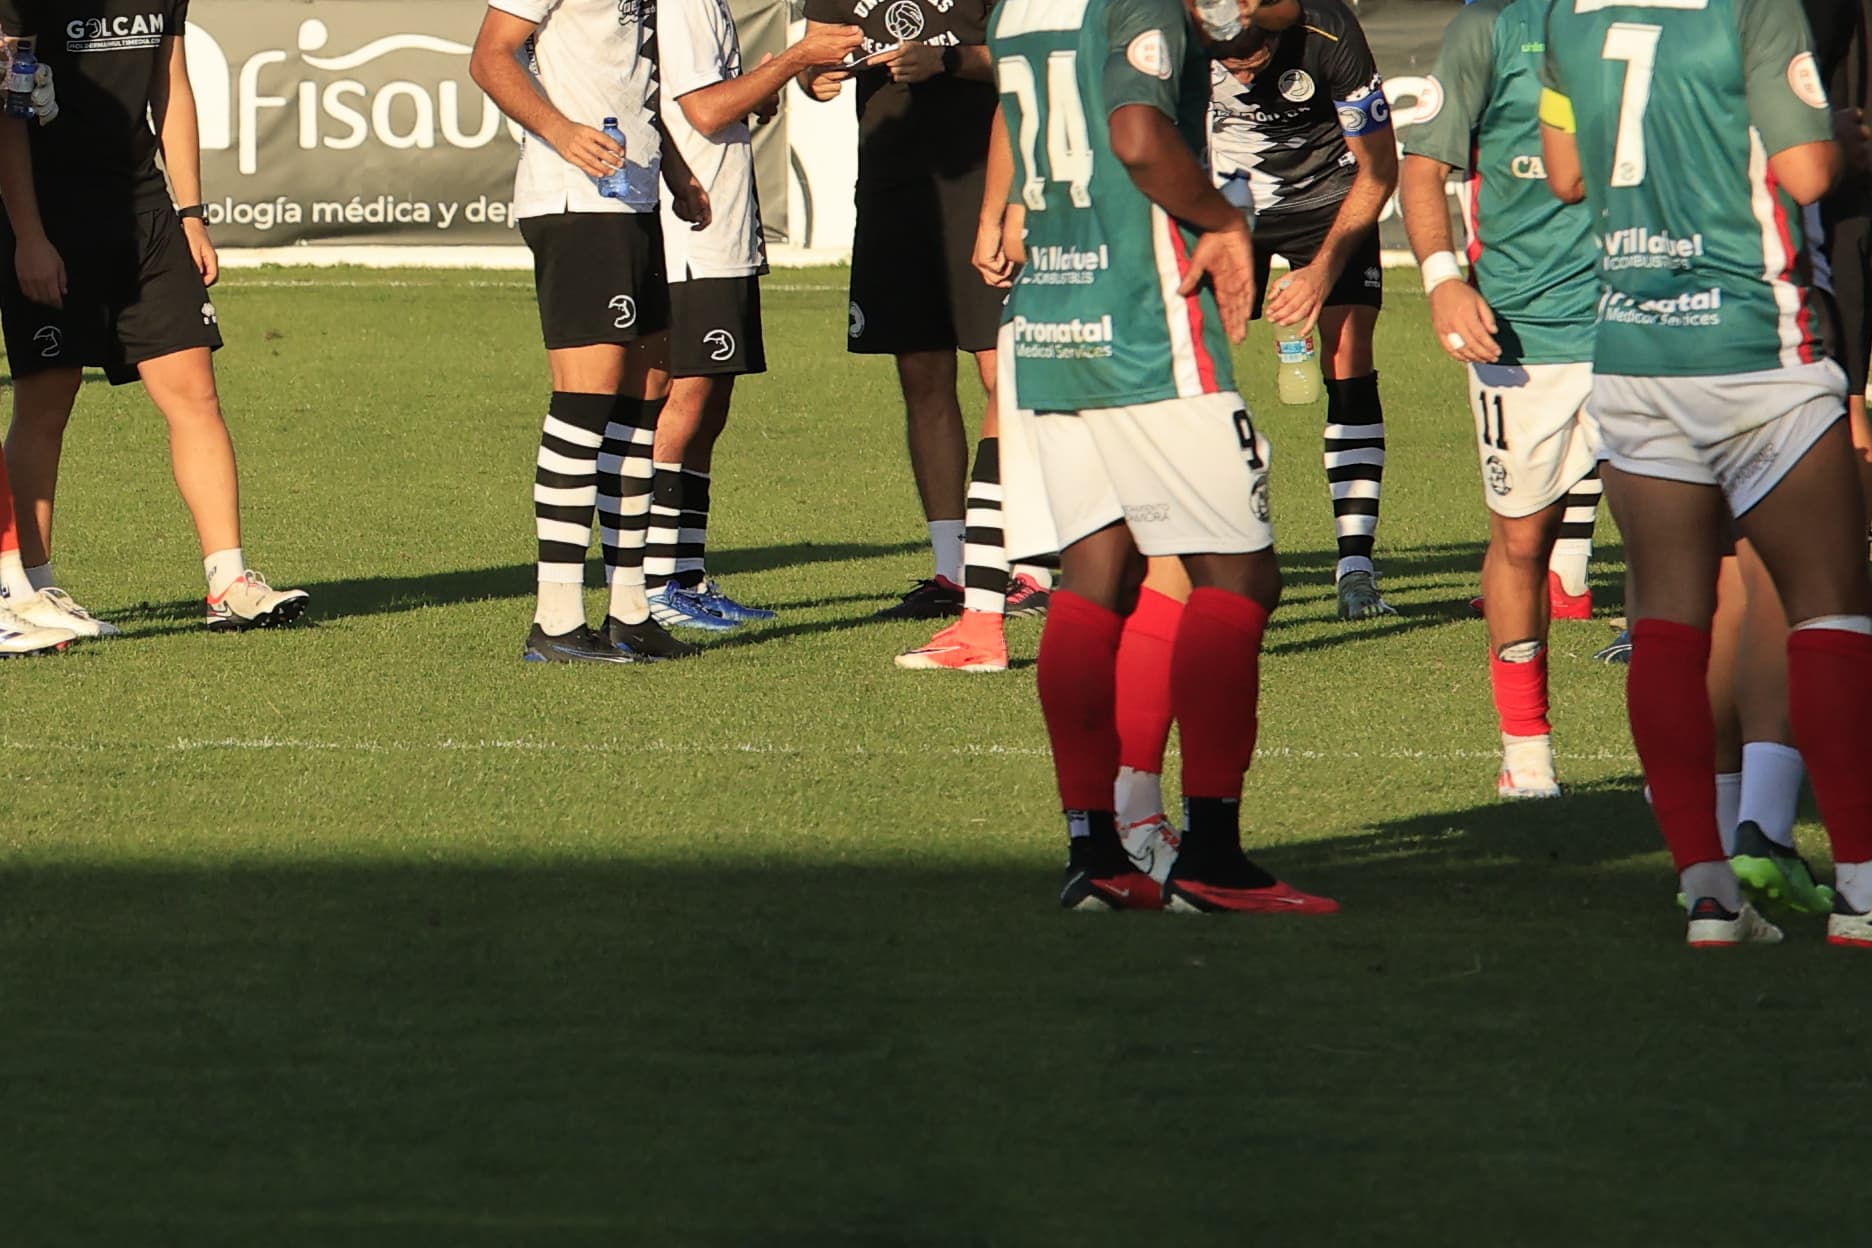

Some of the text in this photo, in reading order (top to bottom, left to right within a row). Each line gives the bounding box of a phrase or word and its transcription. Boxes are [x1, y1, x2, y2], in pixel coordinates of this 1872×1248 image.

[239, 19, 524, 175] fisau
[1370, 98, 1390, 123] C
[1601, 21, 1663, 188] 7
[208, 197, 302, 230] ología
[312, 196, 431, 225] médica
[438, 201, 459, 228] y
[1014, 314, 1113, 344] Pronatal
[1016, 342, 1054, 358] Medical
[1479, 390, 1510, 451] 11
